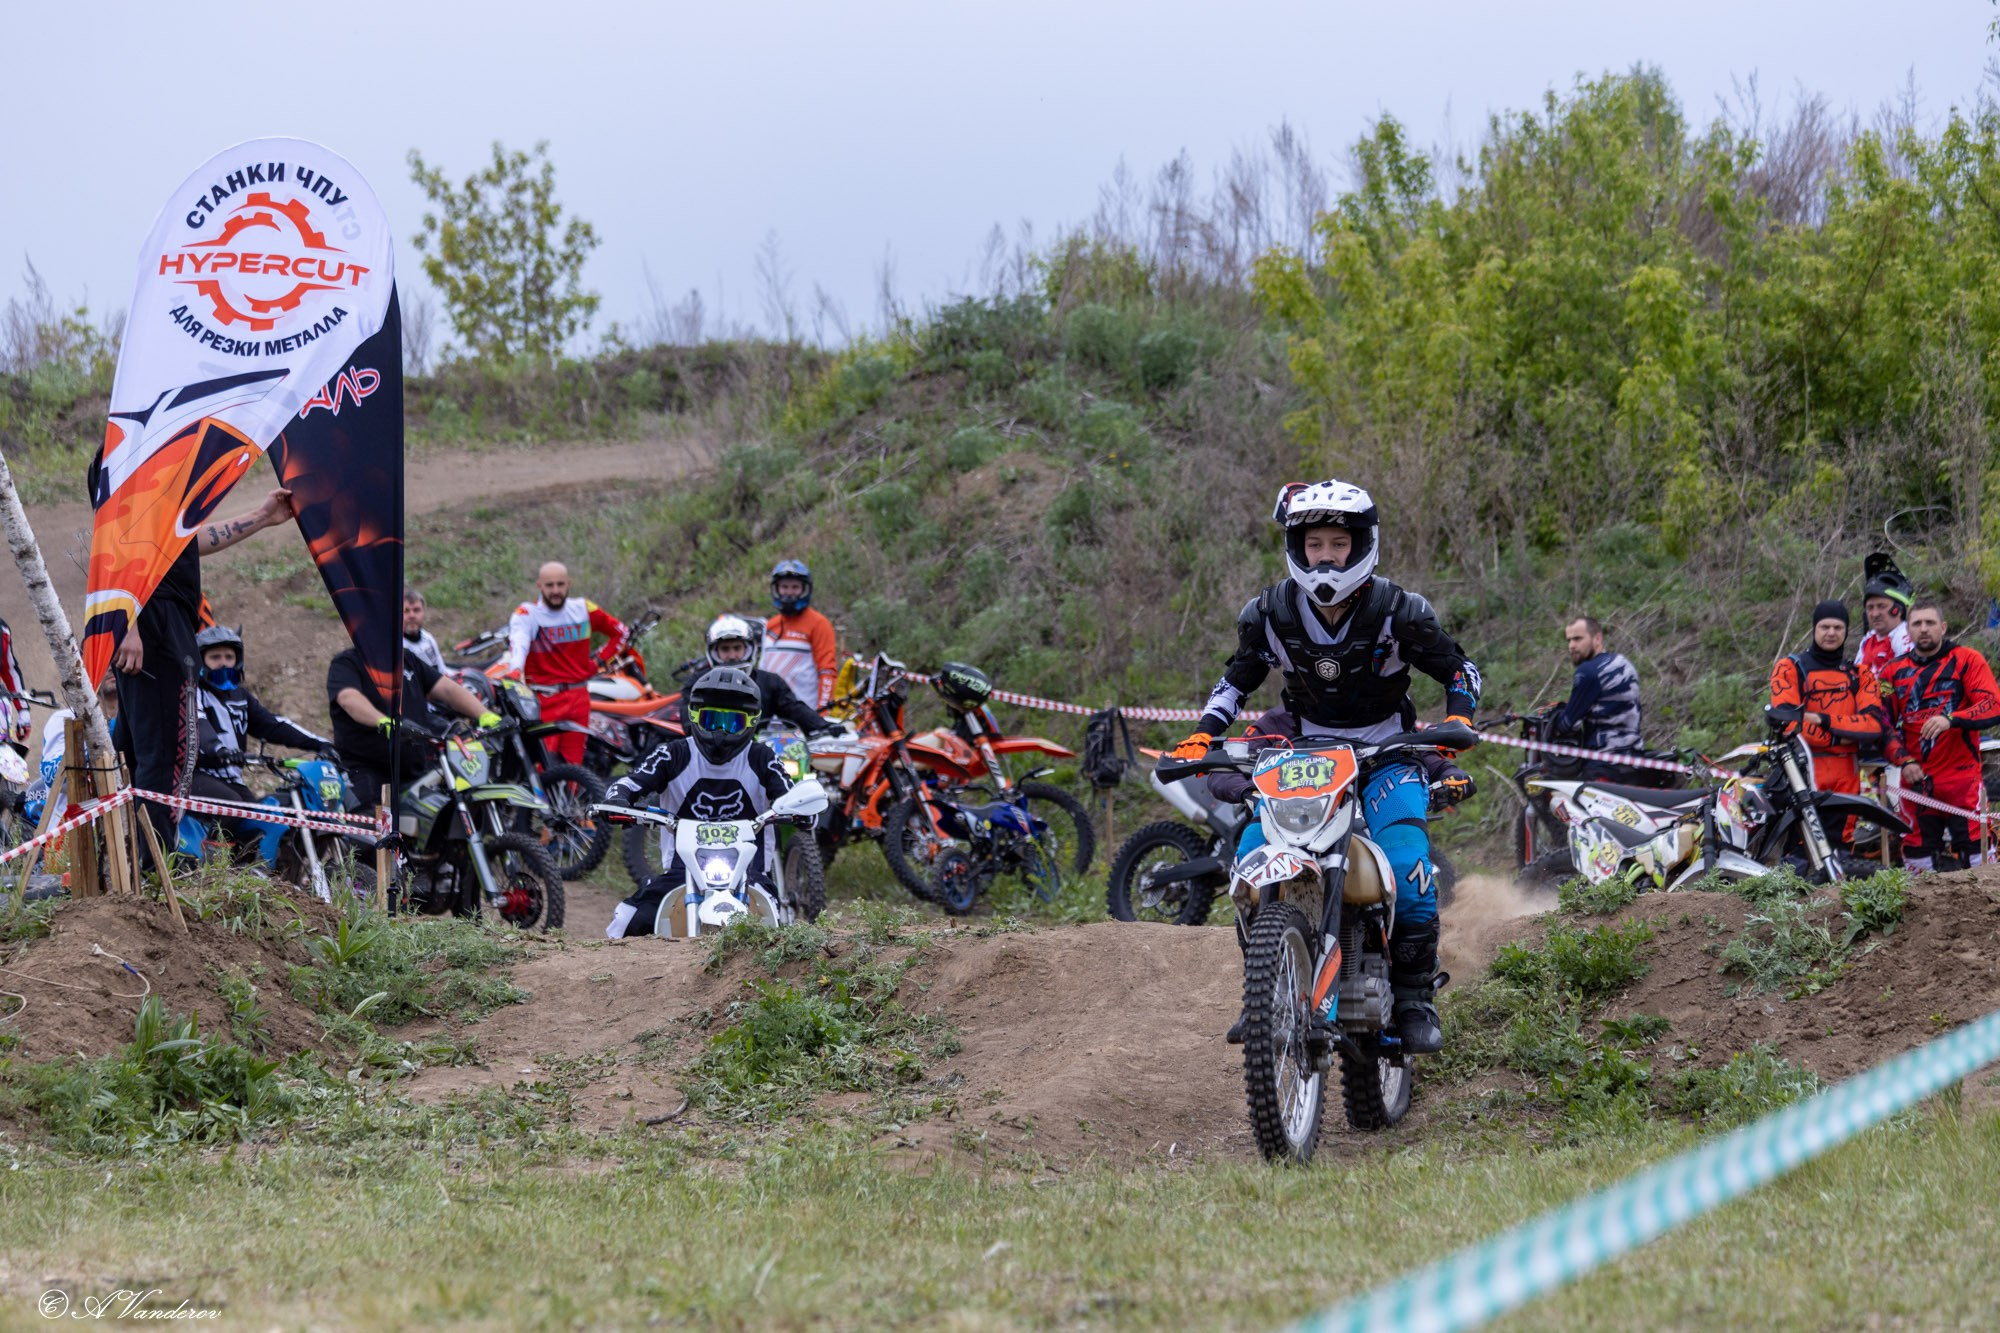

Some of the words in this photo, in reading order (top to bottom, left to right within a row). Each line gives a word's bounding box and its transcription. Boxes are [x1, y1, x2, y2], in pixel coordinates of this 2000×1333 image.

[186, 163, 285, 229] СТАНКИ
[296, 166, 349, 206] ЧПУ
[158, 252, 371, 286] HYPERCUT
[169, 304, 203, 338] ДЛЯ
[200, 331, 260, 357] РЕЗКИ
[265, 305, 348, 356] МЕТАЛЛА
[1256, 750, 1294, 773] KAYO
[1286, 760, 1301, 768] HILL
[1292, 764, 1319, 781] 30
[701, 828, 731, 838] 102
